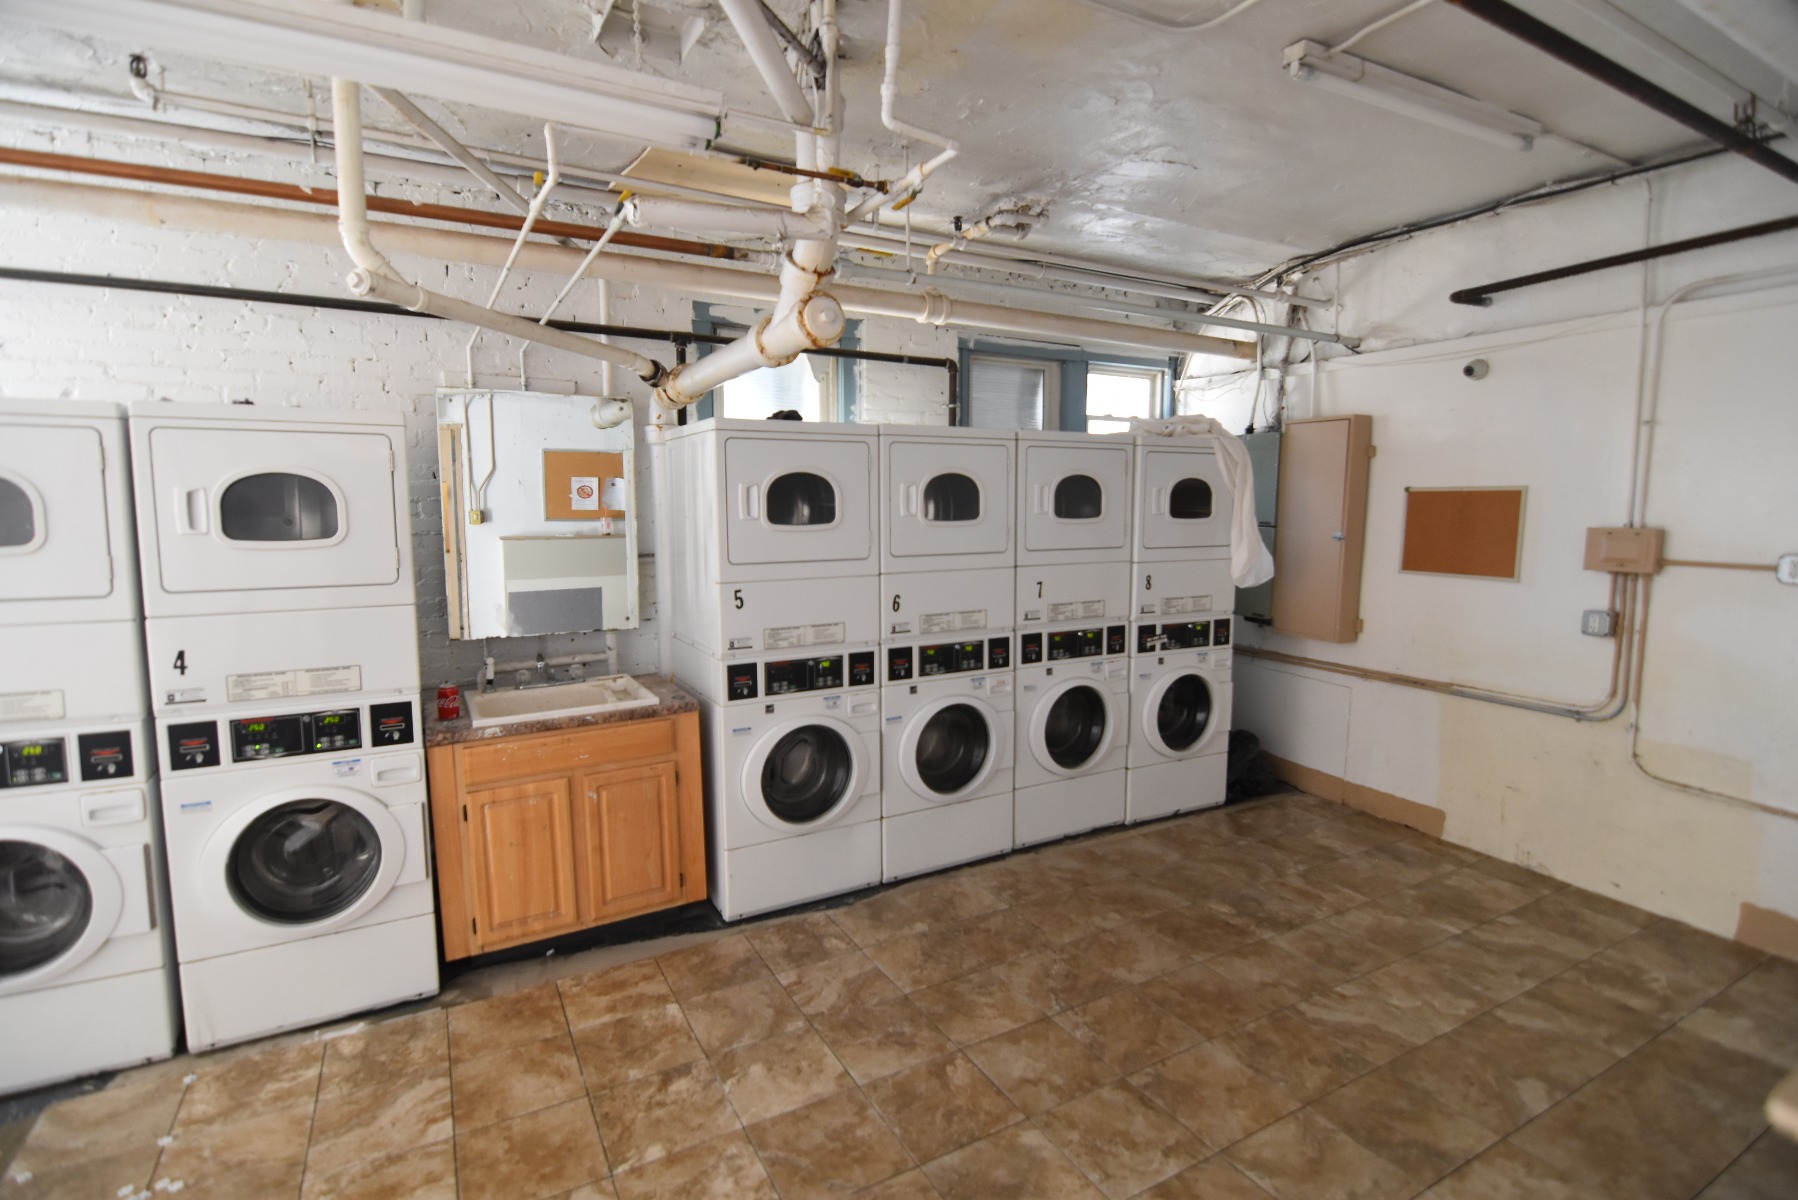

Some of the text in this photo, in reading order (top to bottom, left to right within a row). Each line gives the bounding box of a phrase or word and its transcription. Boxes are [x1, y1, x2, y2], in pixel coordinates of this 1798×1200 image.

[1036, 581, 1043, 599] 7
[1145, 574, 1152, 590] 8
[733, 589, 744, 609] 5
[892, 594, 901, 612] 6
[173, 650, 188, 675] 4
